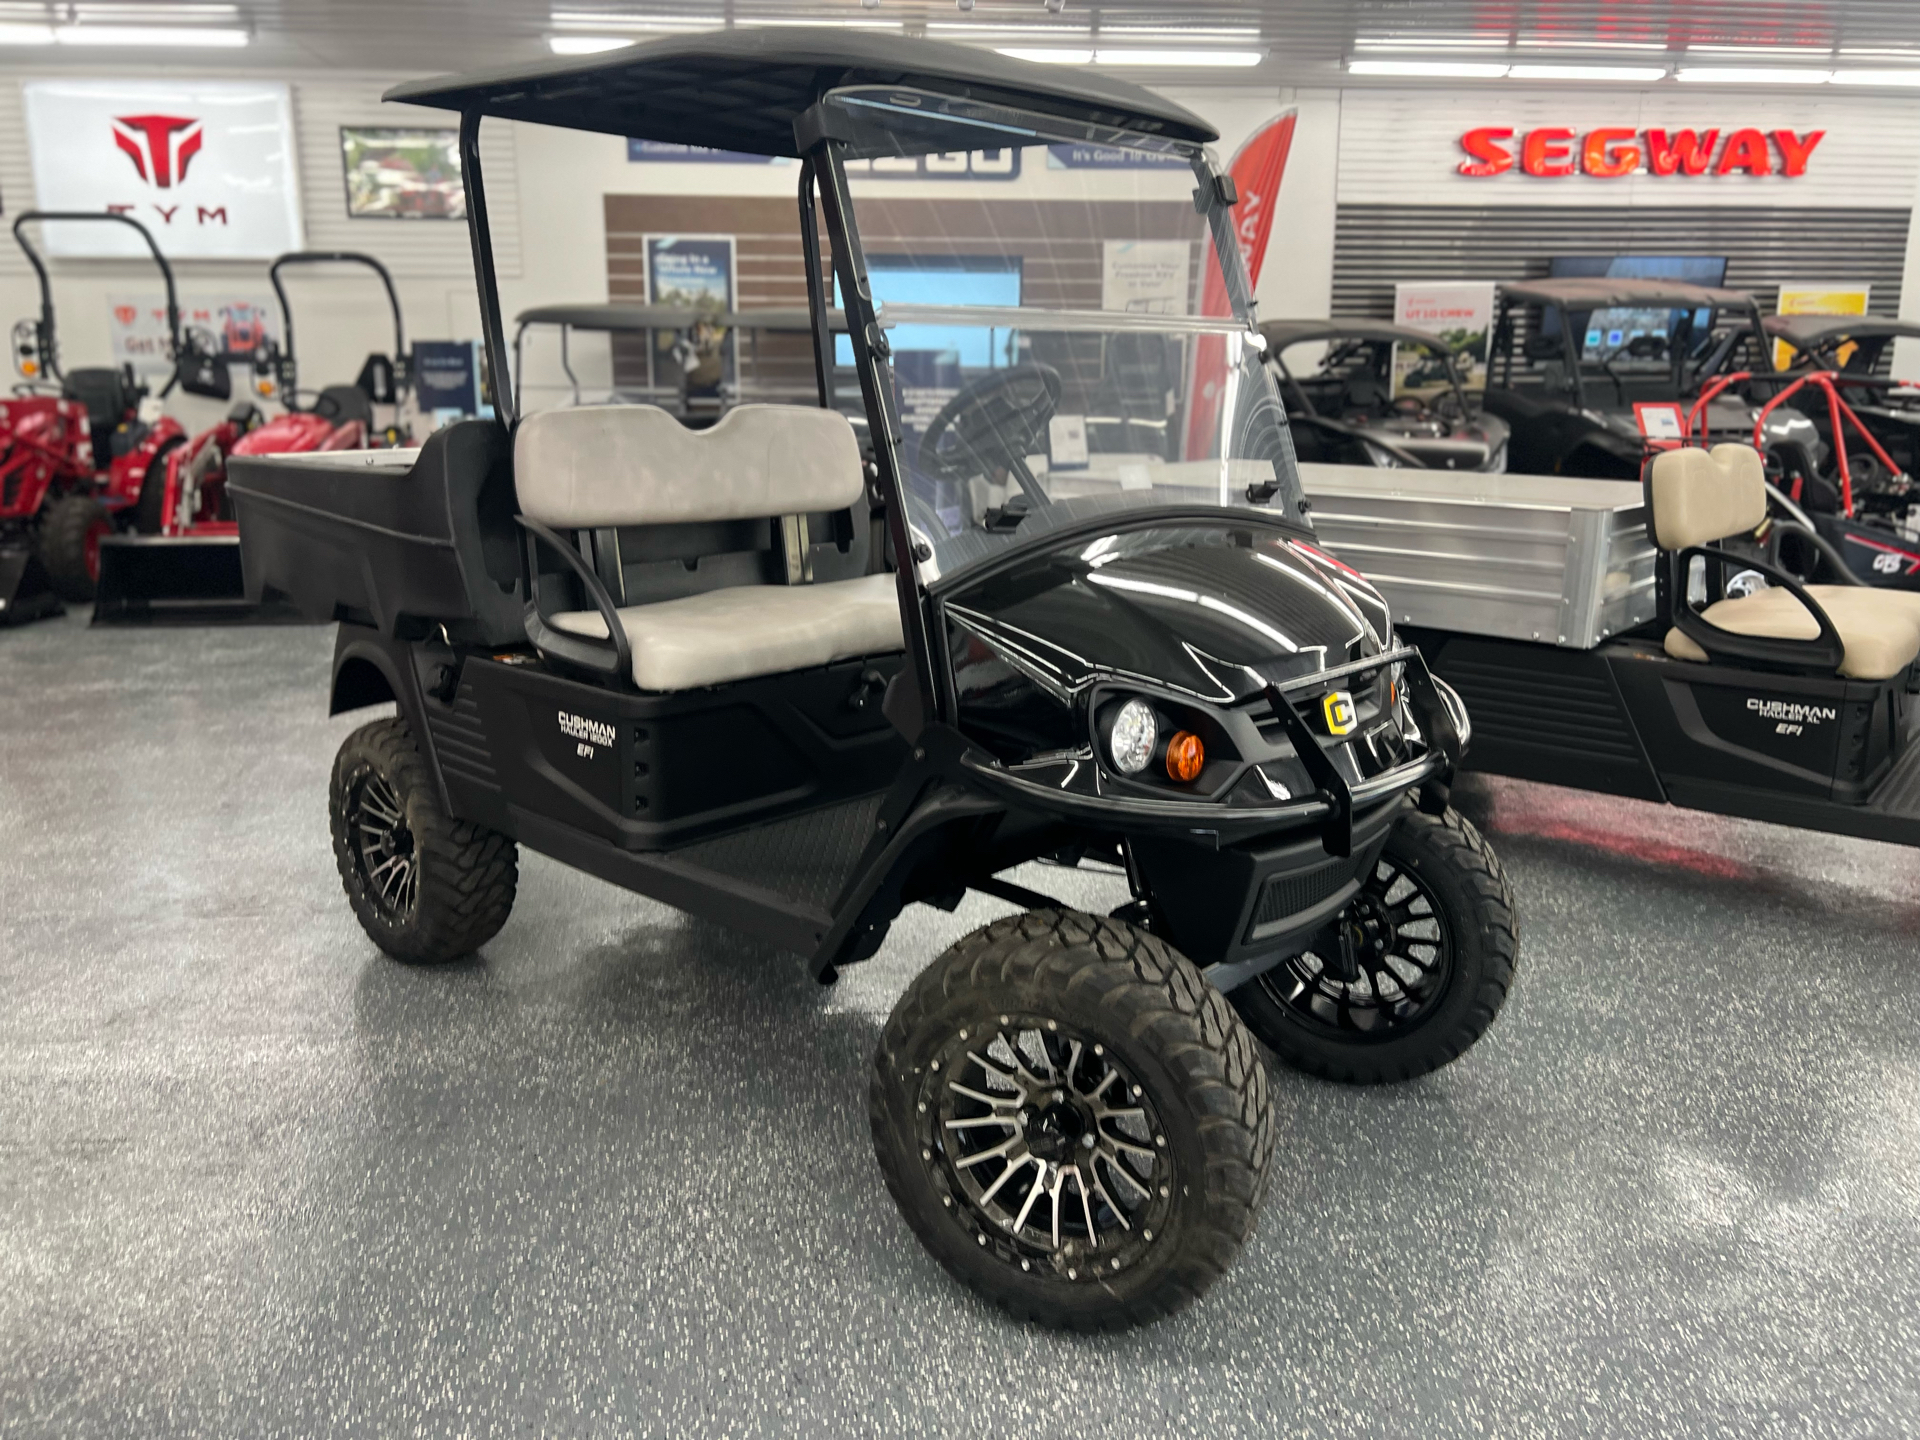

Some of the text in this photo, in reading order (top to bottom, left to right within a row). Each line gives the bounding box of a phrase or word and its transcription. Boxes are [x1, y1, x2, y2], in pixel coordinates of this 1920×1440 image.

[1457, 127, 1827, 178] SEGWAY
[1746, 698, 1836, 720] CUSHMAN
[558, 710, 616, 740] CUSHMAN
[1775, 722, 1803, 736] EFI
[577, 742, 594, 760] EFI
